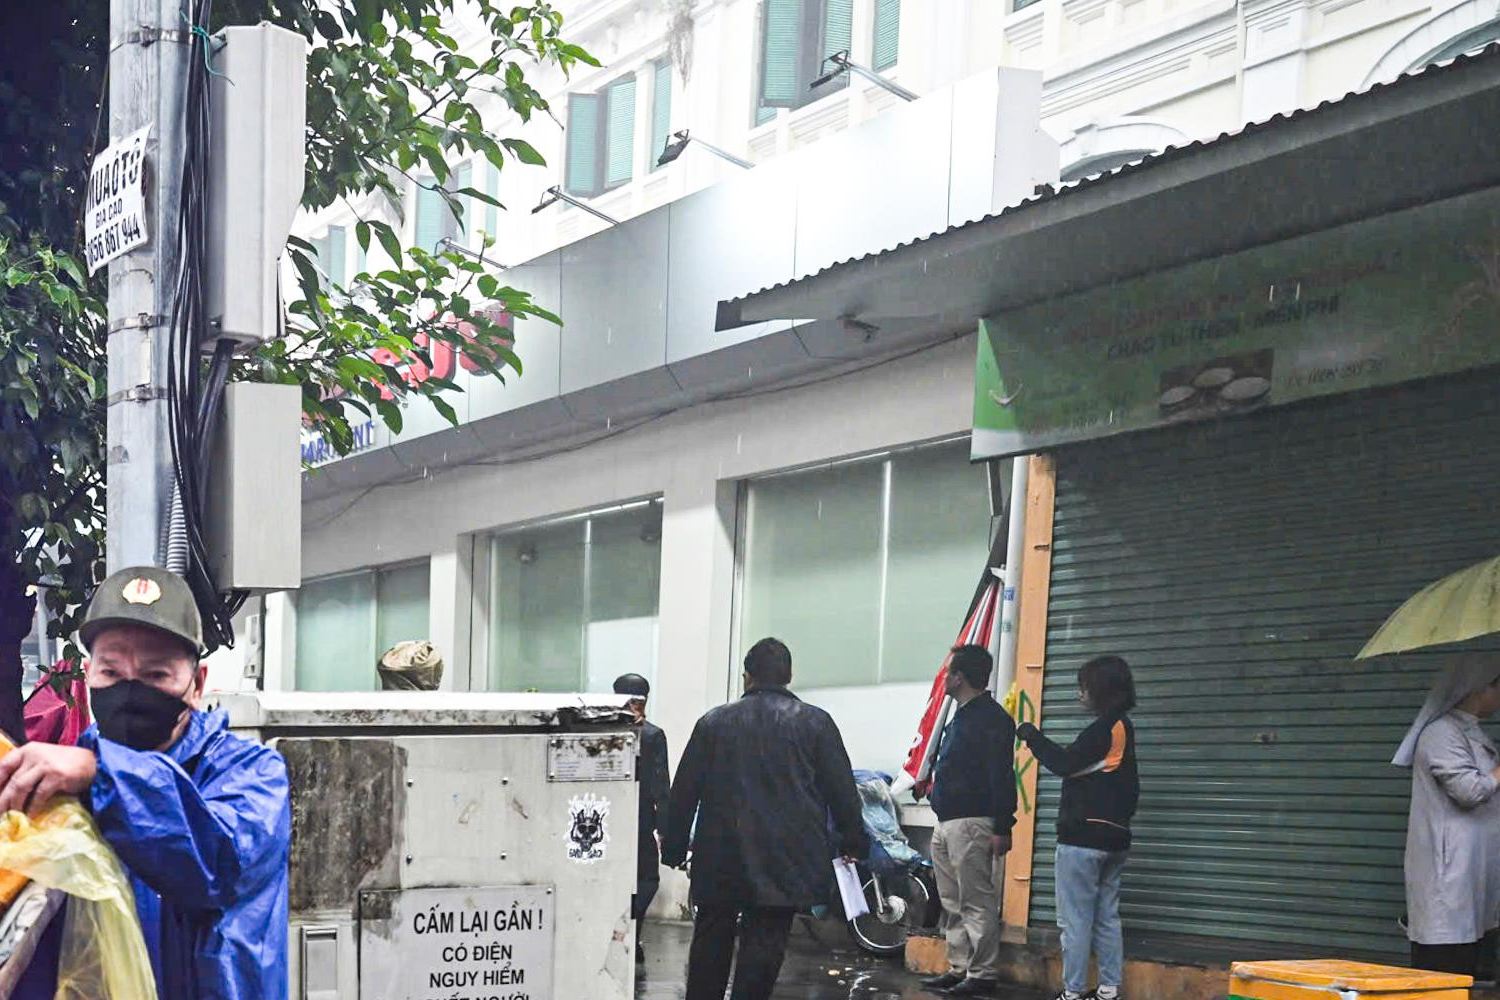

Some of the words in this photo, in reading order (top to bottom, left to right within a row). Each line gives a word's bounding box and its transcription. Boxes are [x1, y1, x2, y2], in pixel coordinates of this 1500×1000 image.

[121, 212, 141, 245] 944
[413, 902, 454, 935] CẤM
[460, 910, 488, 938] LẠI
[493, 900, 532, 931] GẦN
[442, 942, 468, 963] CÓ
[472, 941, 512, 964] ĐIỆN
[429, 970, 478, 988] NGUY
[483, 961, 524, 985] HIỂM
